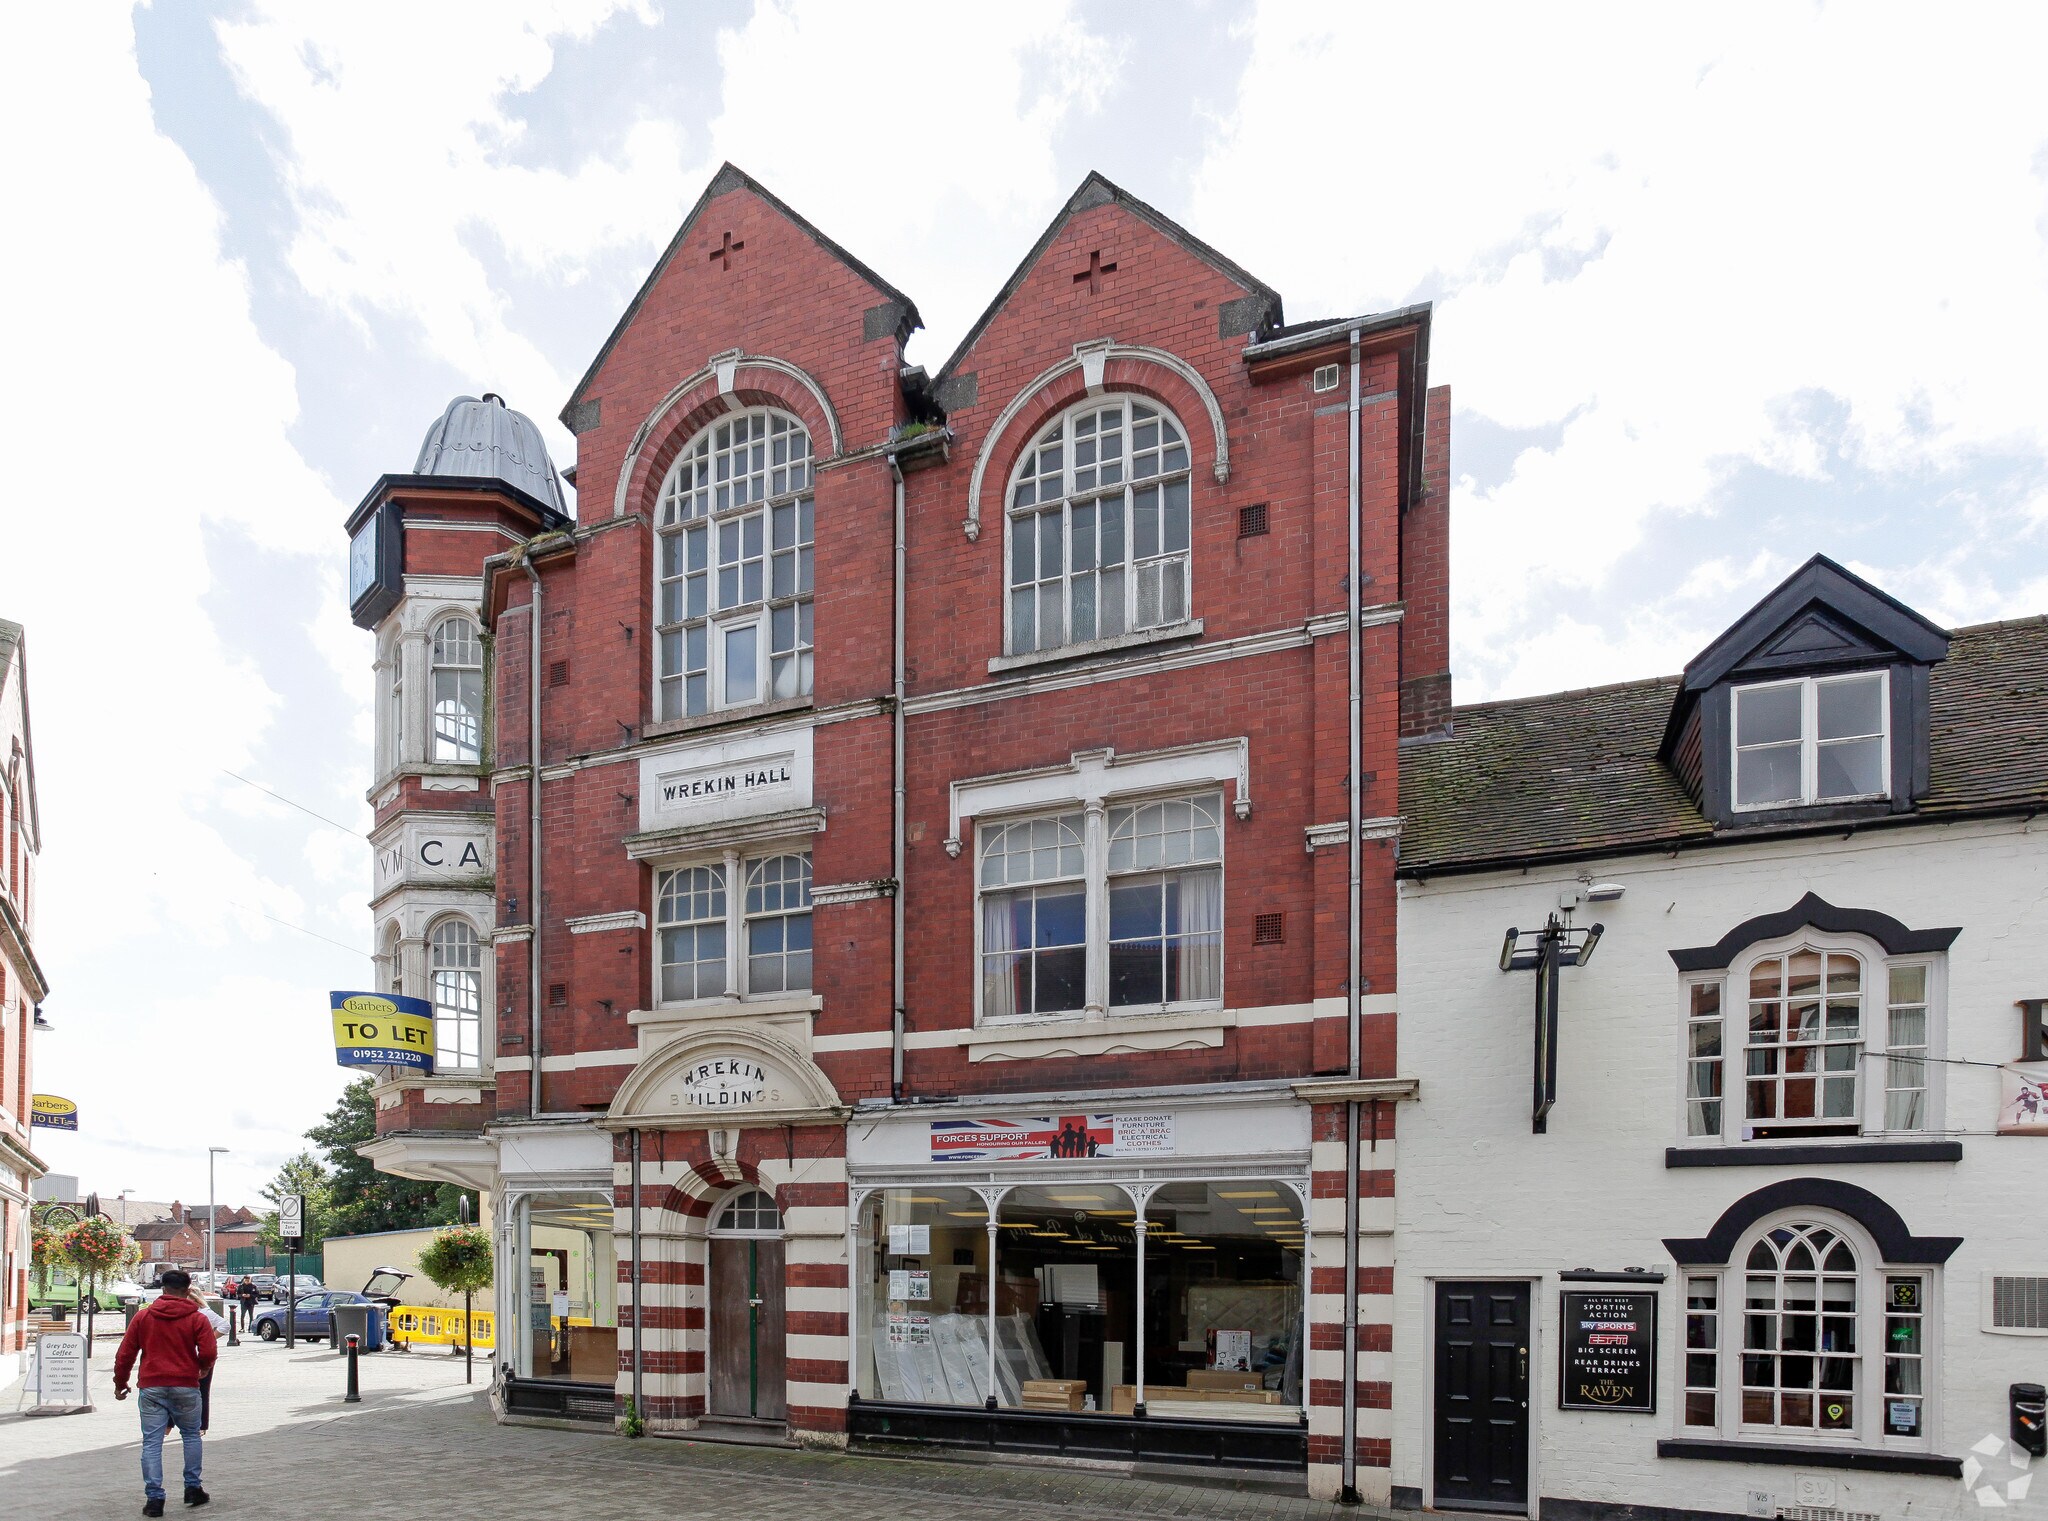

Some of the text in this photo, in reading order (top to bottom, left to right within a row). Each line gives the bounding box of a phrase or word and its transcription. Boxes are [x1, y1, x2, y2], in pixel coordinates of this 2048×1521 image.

[663, 768, 790, 800] WREKIN HALL
[349, 1000, 393, 1013] Barbers
[343, 1023, 428, 1045] TO LET
[353, 1050, 422, 1062] 01952 221220
[684, 1060, 765, 1092] WREKIN
[32, 1114, 46, 1123] TO
[48, 1116, 66, 1125] LET
[936, 1132, 1030, 1143] FORCES SUPPORT
[1597, 1322, 1634, 1330] SPORTS
[1588, 1334, 1629, 1345] ESPN
[52, 1349, 73, 1357] Coffee
[1580, 1384, 1634, 1400] RAVEN
